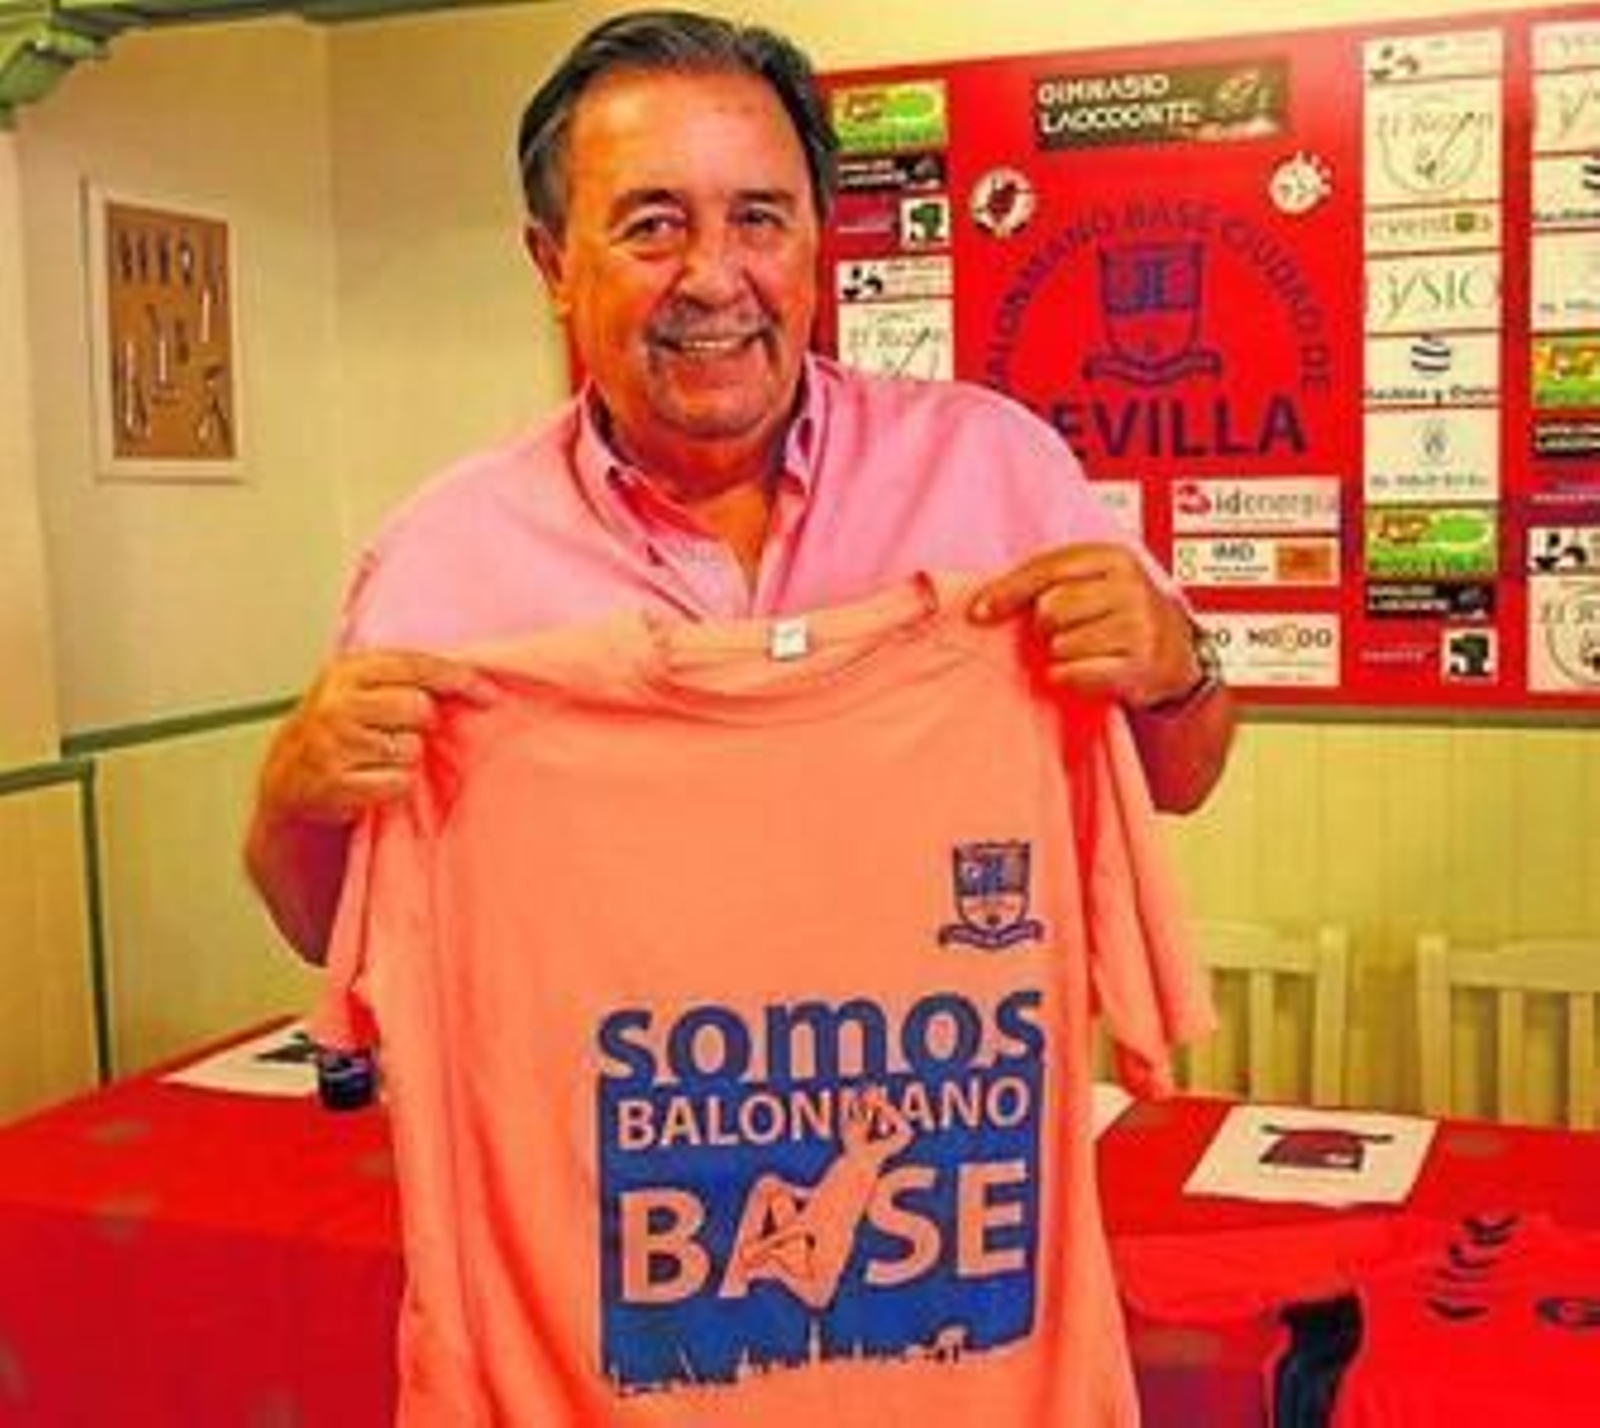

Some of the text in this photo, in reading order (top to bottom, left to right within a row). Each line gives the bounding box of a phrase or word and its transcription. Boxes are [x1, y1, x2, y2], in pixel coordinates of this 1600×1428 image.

[1038, 74, 1170, 104] GIMNASIO
[986, 203, 1115, 388] ALONMANO
[1046, 395, 1307, 461] EVILLA
[617, 1159, 1028, 1304] BASE
